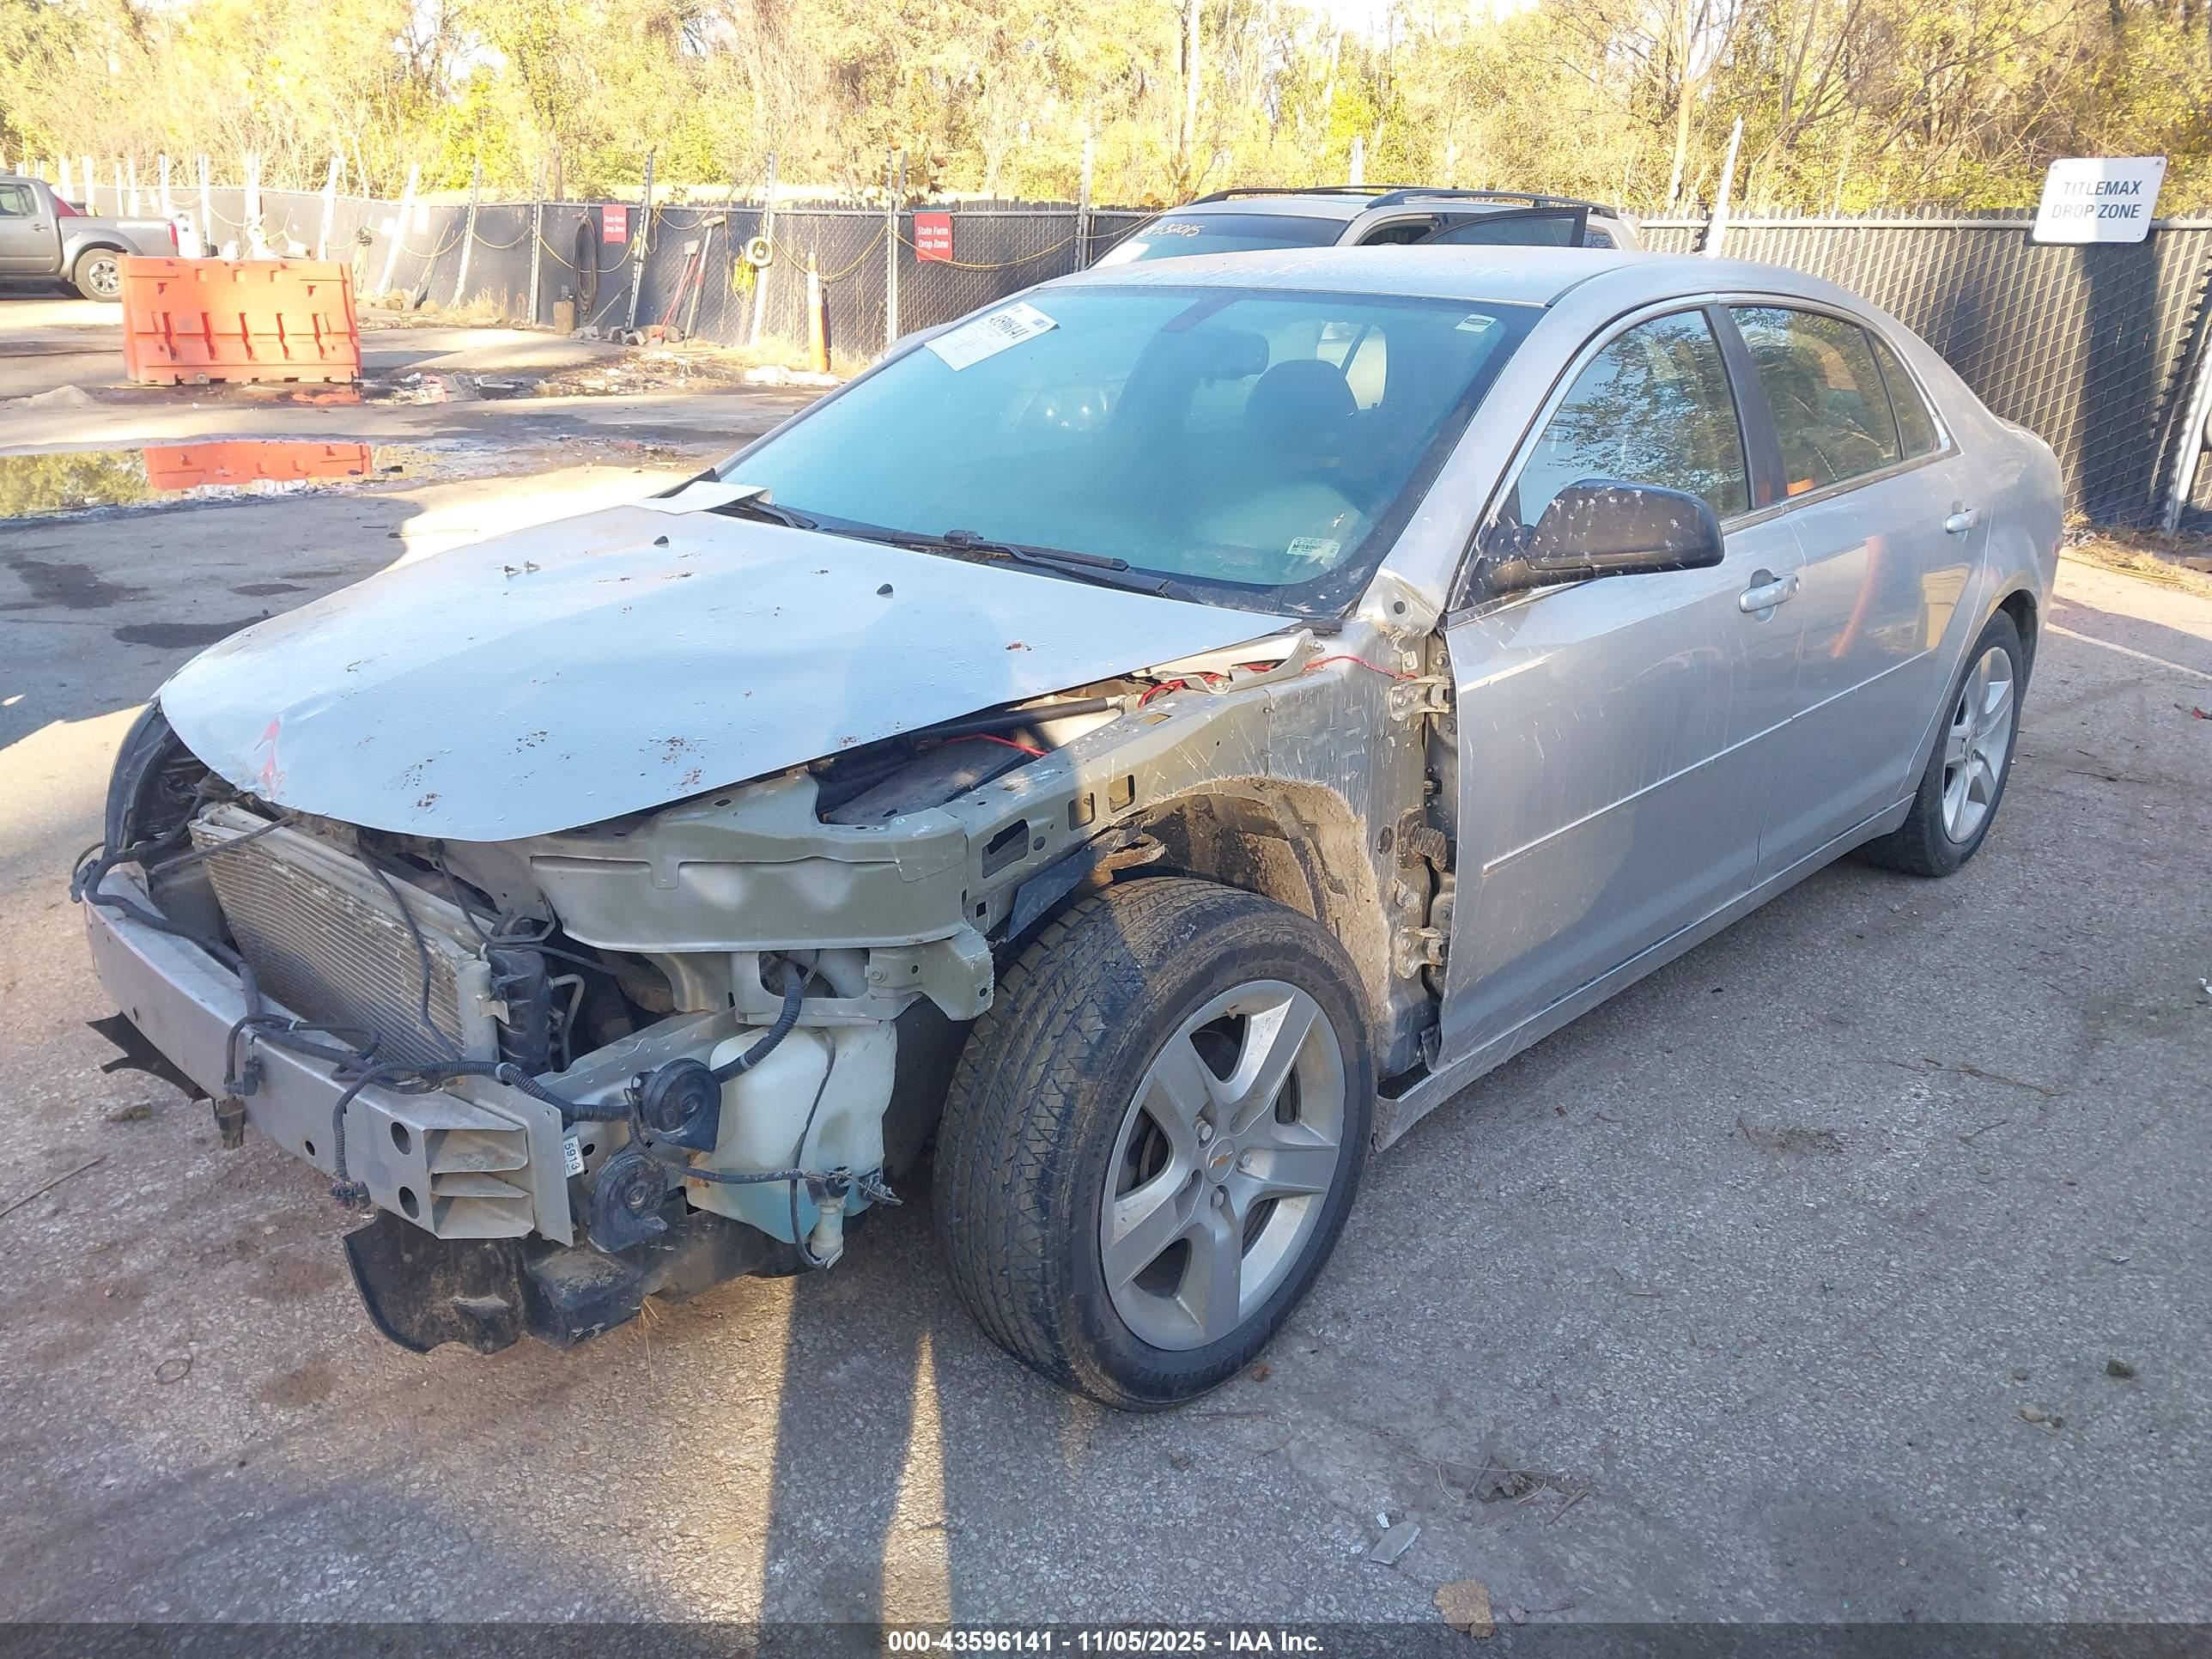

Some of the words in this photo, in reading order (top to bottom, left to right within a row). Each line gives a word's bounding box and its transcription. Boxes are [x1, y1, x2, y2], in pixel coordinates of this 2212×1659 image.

[2063, 180, 2143, 196] TITLEMAX
[2051, 204, 2095, 219] DROP
[2098, 204, 2142, 219] ZONE
[917, 226, 933, 235] State
[933, 226, 949, 235] Farm
[918, 239, 933, 250] Drop
[933, 239, 949, 248] Zone
[563, 1142, 580, 1170] 5913
